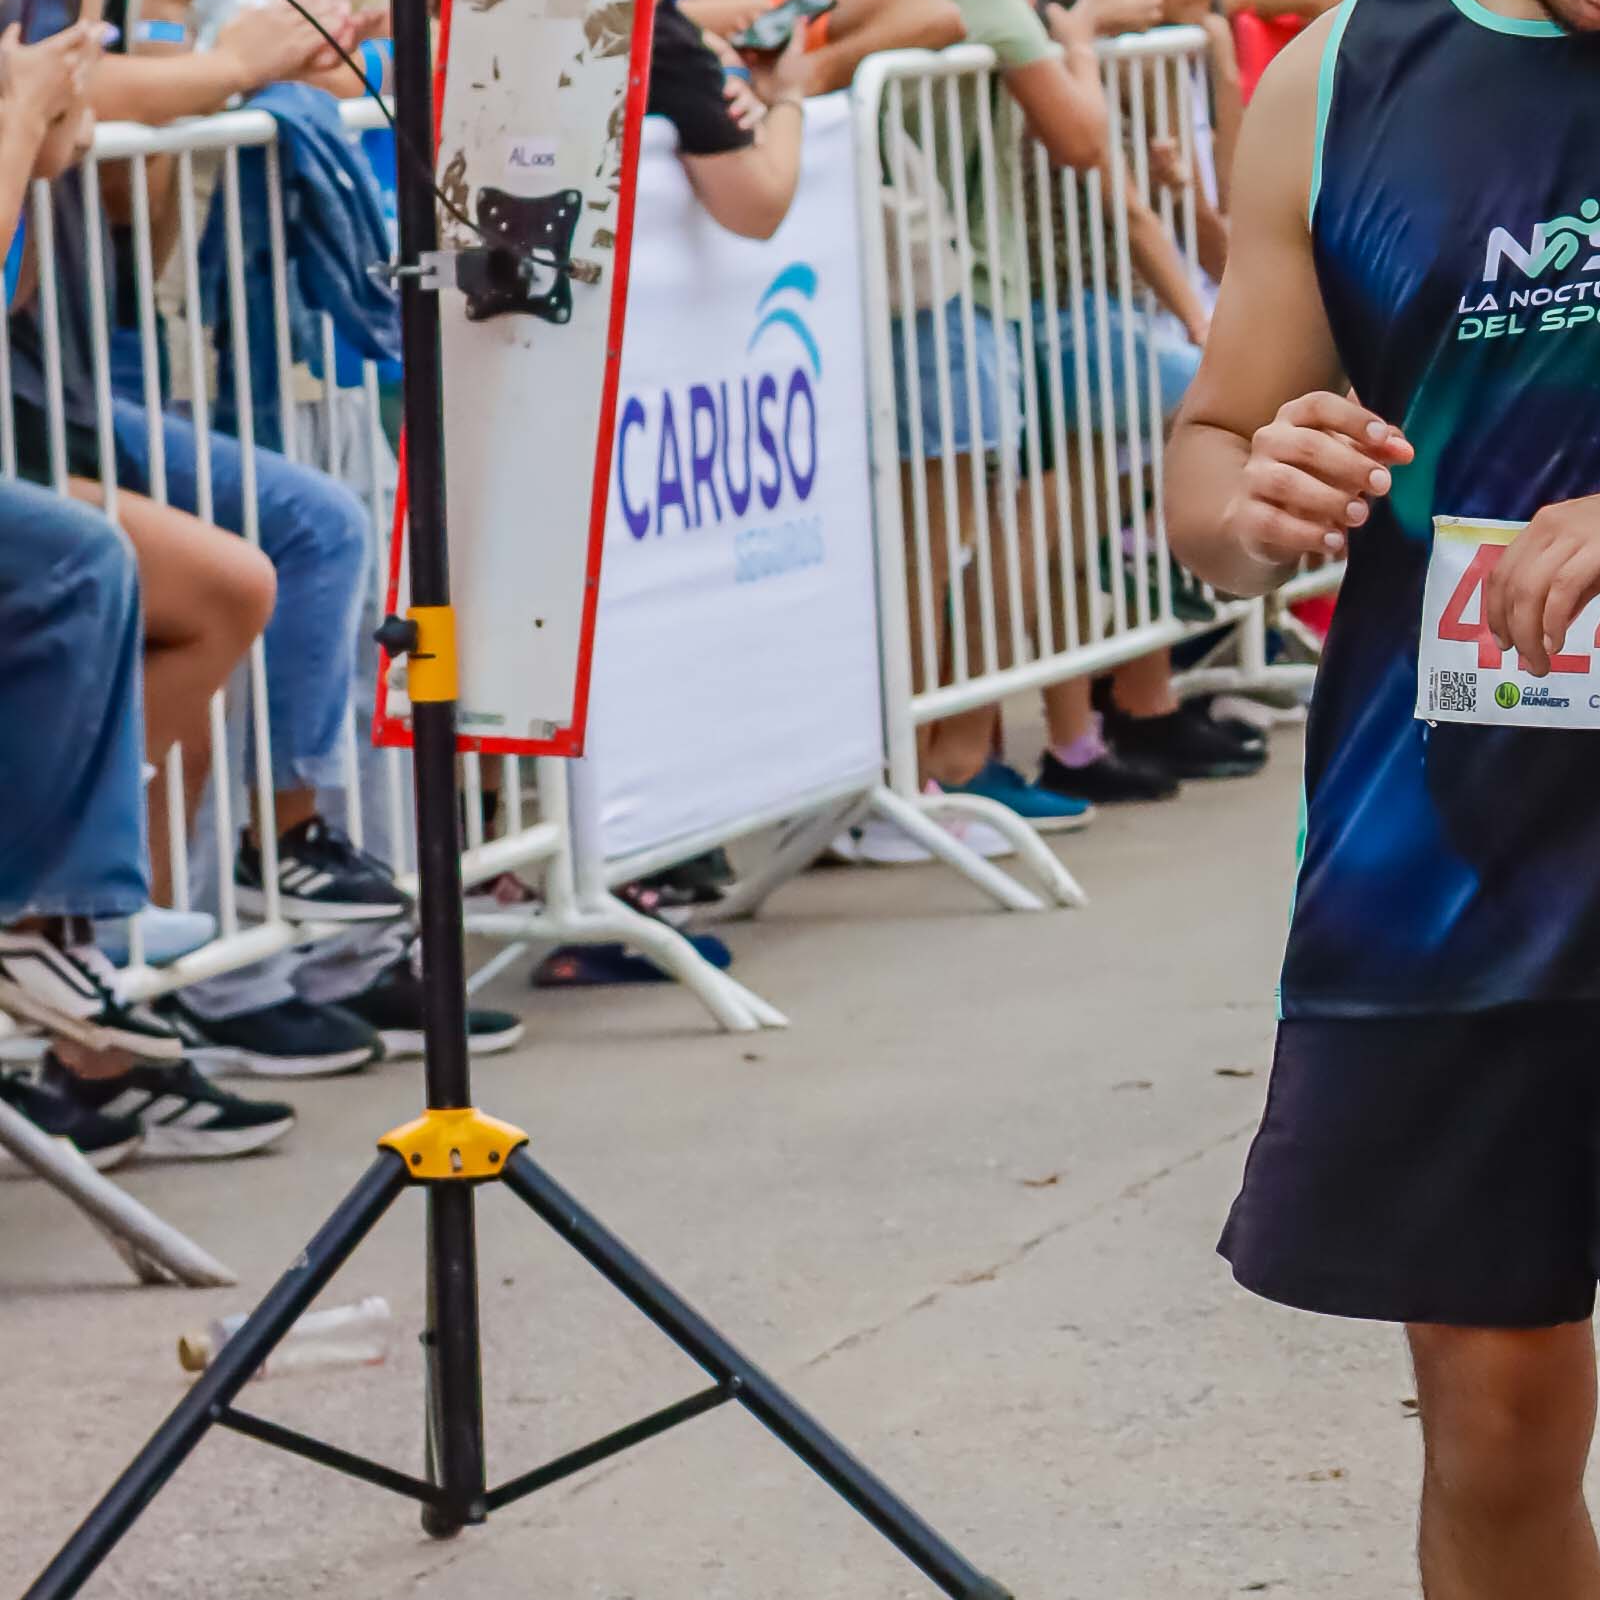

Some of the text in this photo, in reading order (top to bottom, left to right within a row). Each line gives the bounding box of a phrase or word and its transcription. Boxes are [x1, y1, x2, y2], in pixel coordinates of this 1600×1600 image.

[1458, 293, 1499, 314] LA
[1457, 315, 1526, 341] DEL
[617, 364, 817, 541] CARUSO
[1523, 686, 1549, 697] CLUB
